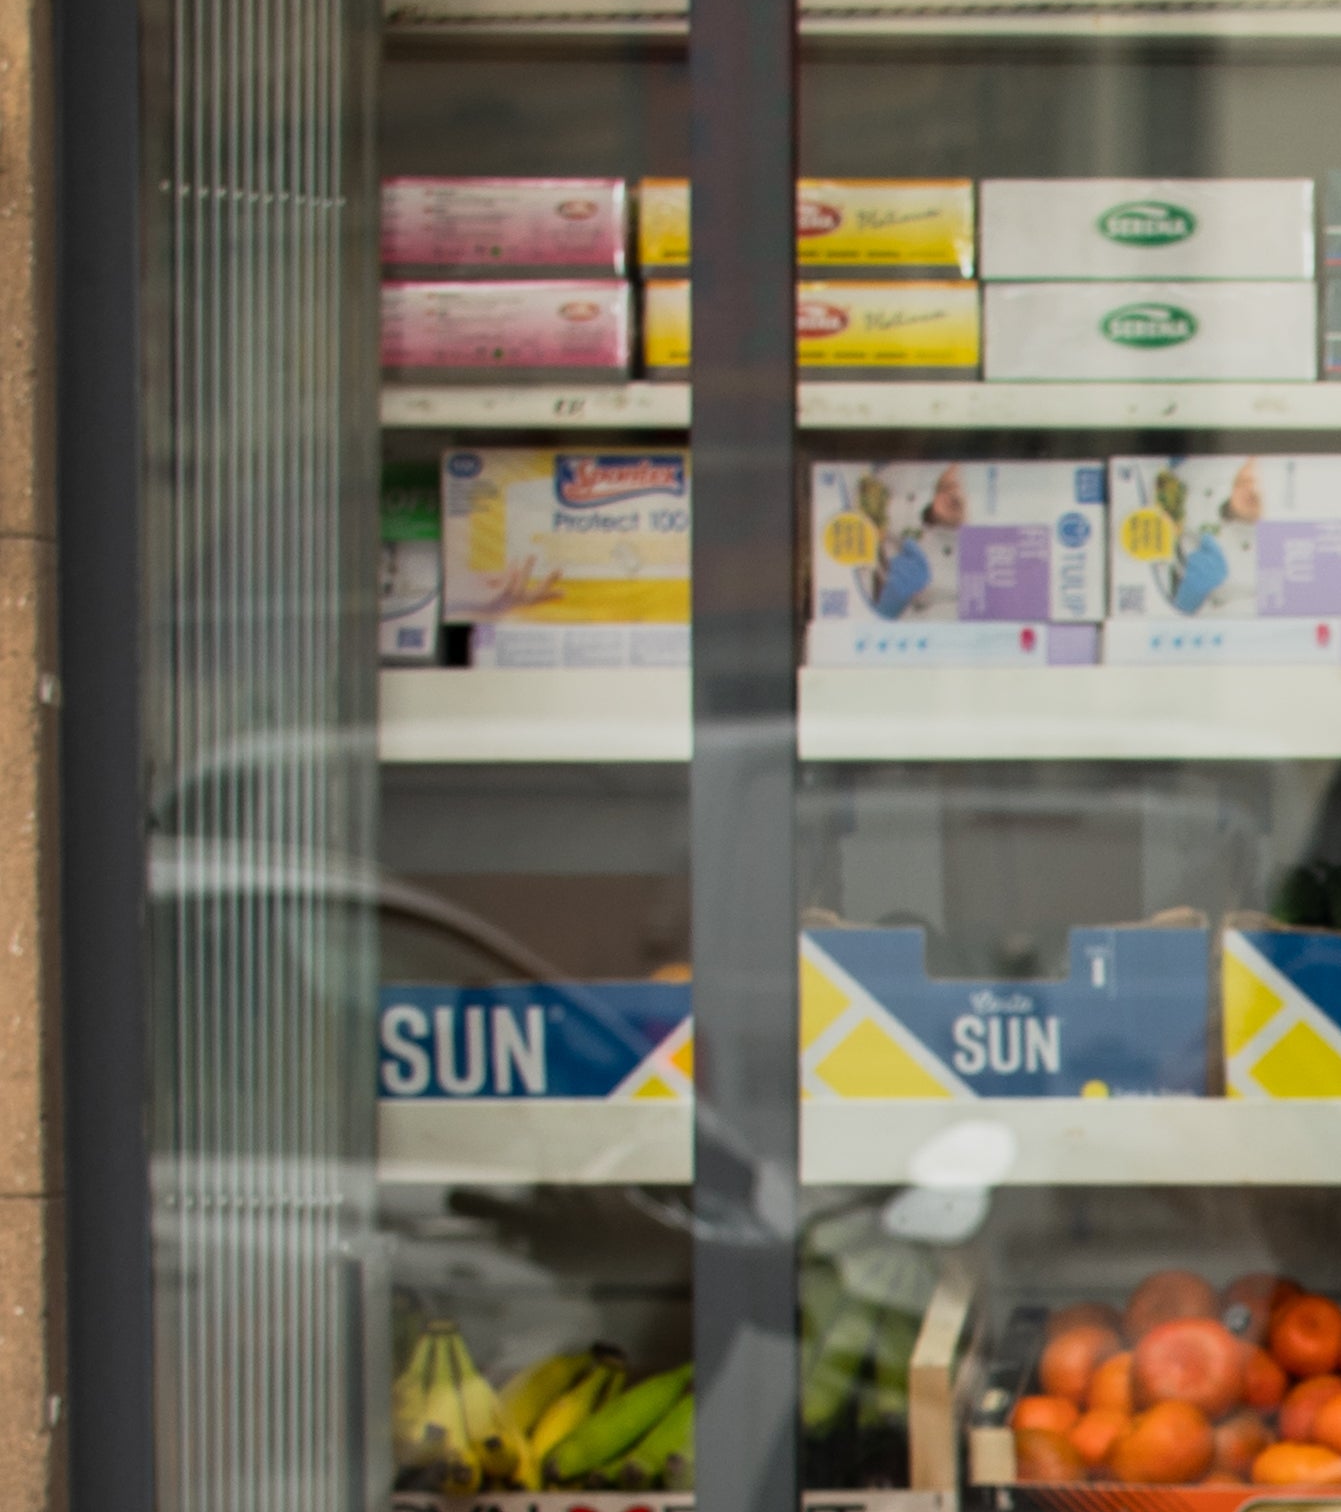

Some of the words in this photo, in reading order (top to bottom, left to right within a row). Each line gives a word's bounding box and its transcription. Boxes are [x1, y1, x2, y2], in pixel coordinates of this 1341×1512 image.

[553, 511, 639, 534] Protect
[1065, 550, 1087, 615] TULIP
[381, 1004, 547, 1095] SUN
[953, 1016, 1062, 1077] SUN
